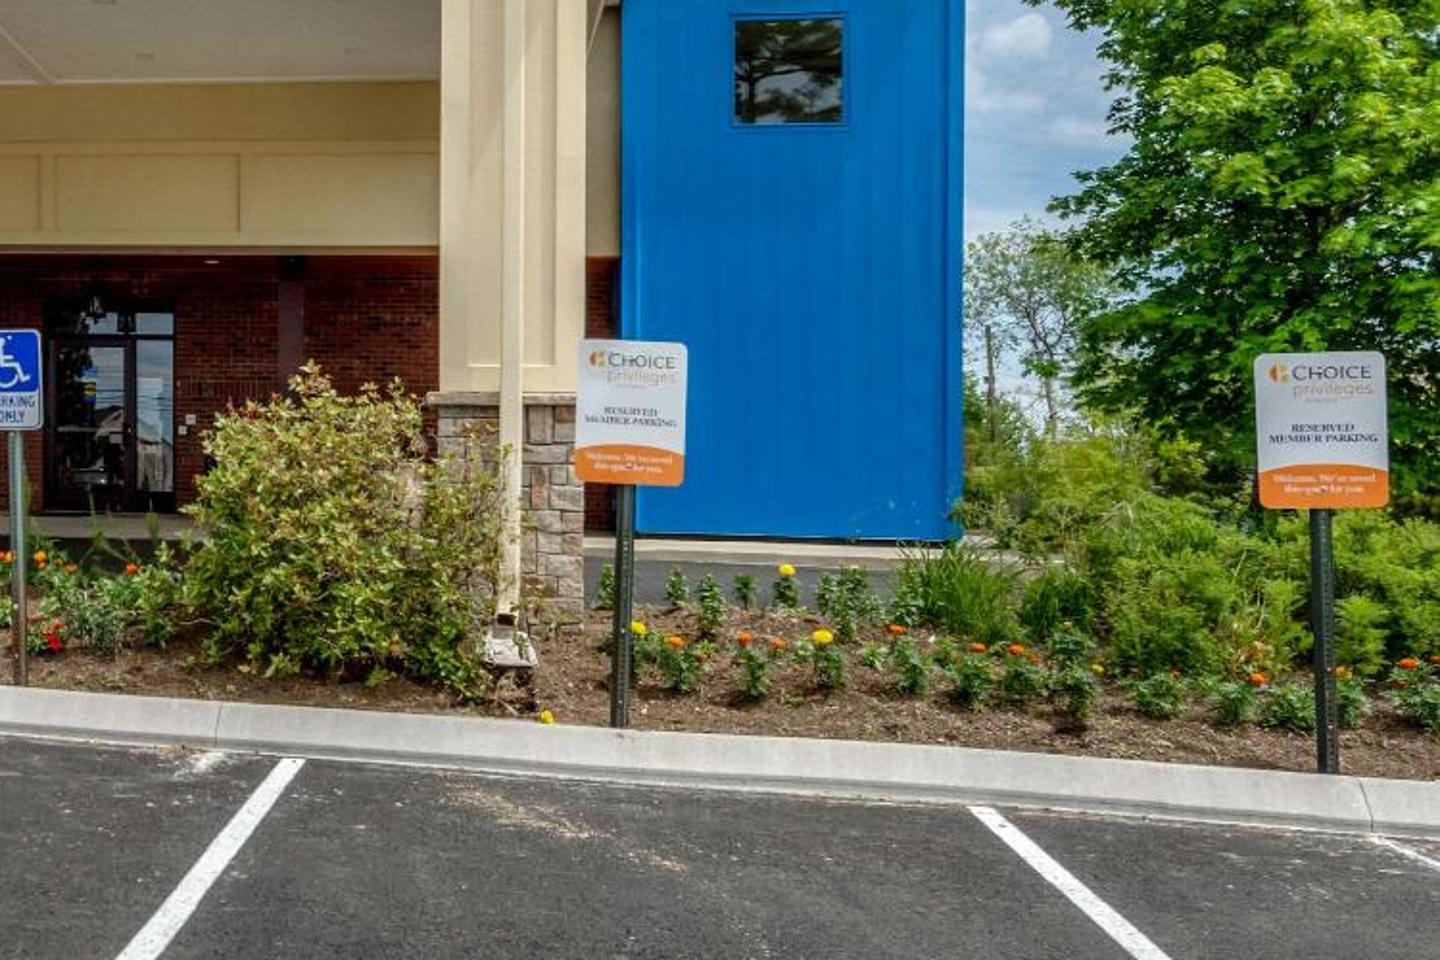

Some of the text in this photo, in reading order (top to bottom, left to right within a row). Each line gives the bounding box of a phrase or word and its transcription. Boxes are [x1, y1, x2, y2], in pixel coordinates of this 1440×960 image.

[608, 352, 677, 370] CHOICE
[1292, 365, 1372, 381] CHOICE
[603, 406, 658, 417] RESERVED
[632, 417, 677, 428] PARKING
[1291, 423, 1355, 433] RESERVED
[1269, 433, 1378, 443] MEMBER PARKING
